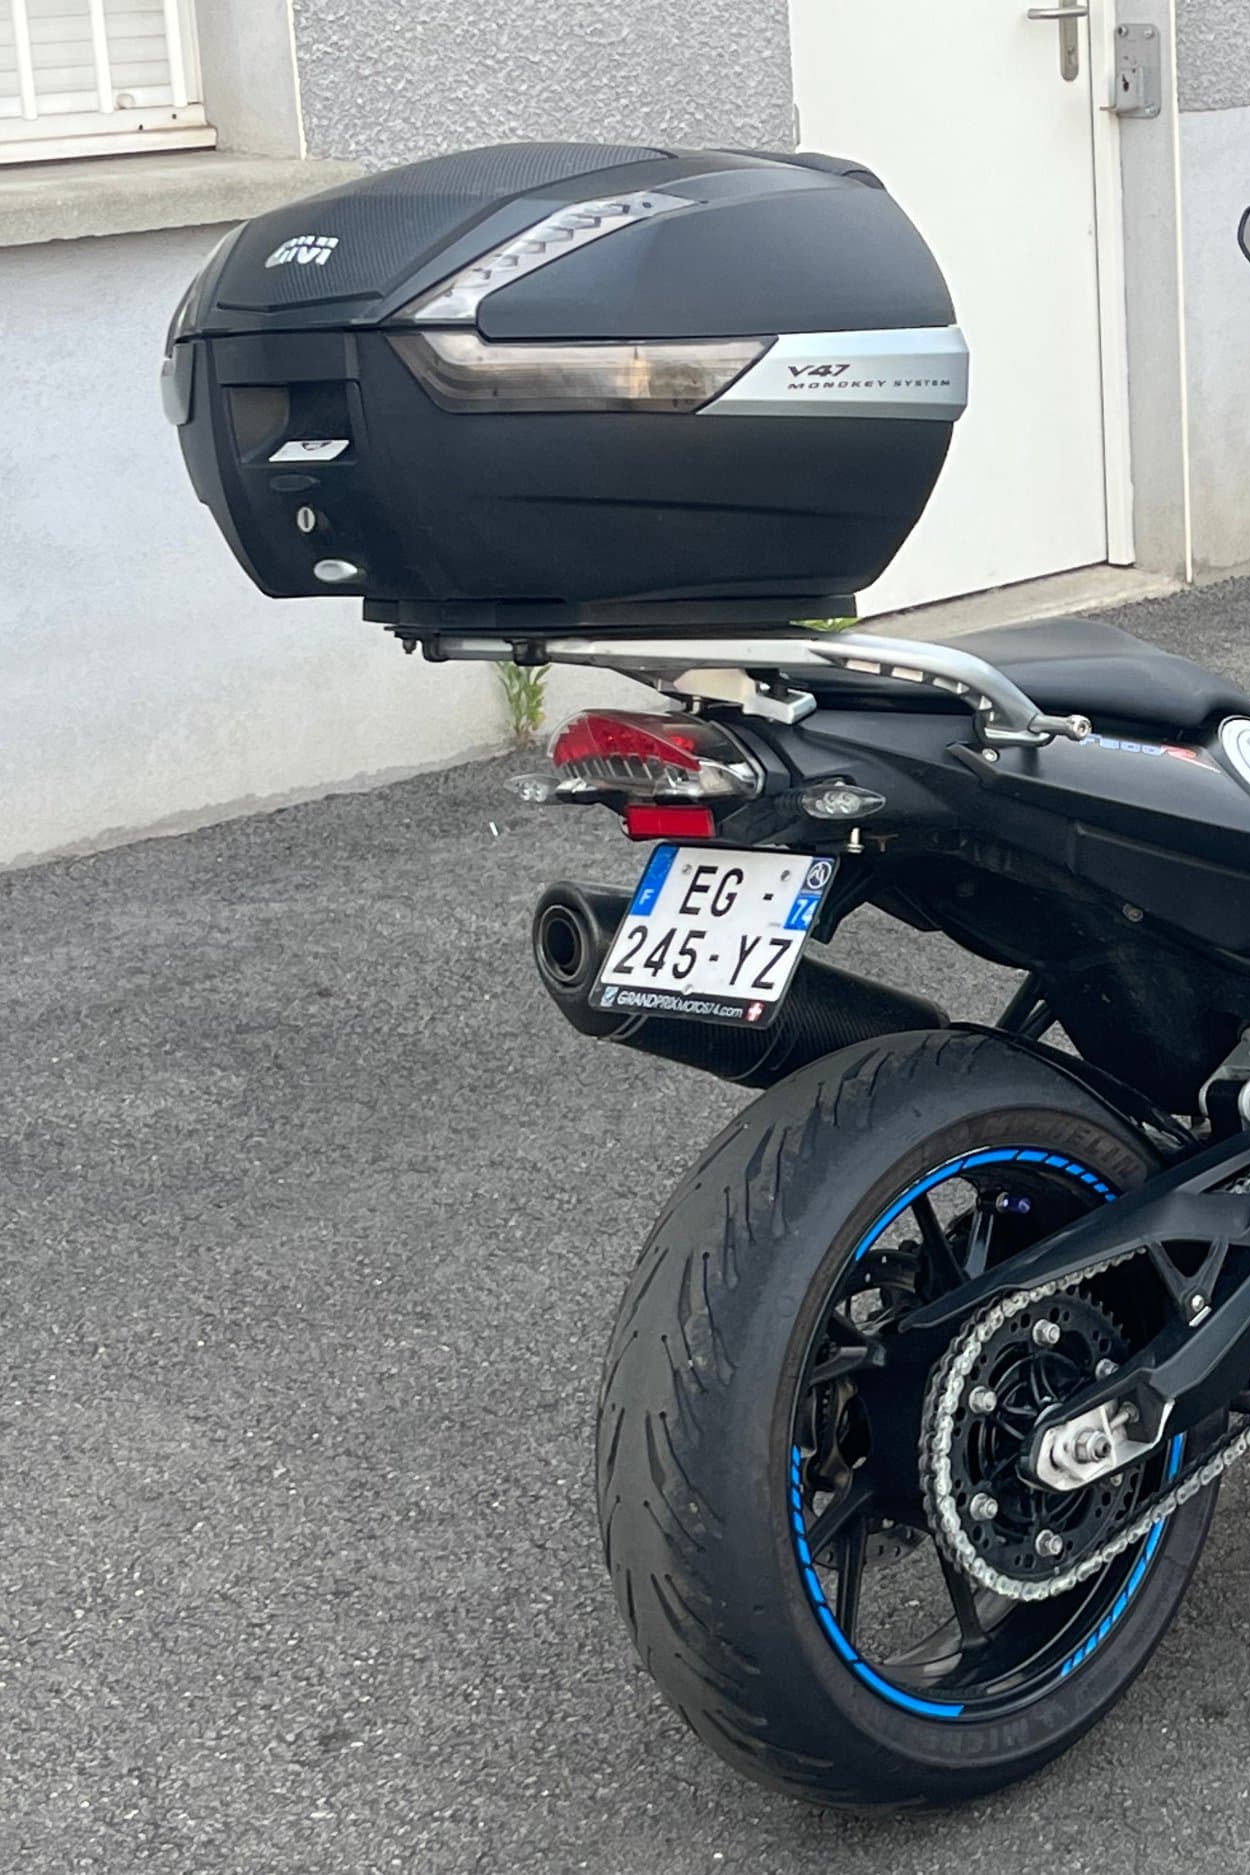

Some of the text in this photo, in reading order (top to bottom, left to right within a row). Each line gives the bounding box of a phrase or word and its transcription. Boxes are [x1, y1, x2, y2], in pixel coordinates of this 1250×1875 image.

[264, 235, 339, 268] GIVI
[788, 364, 850, 377] V47
[787, 379, 951, 389] MONOKEY SYSTEM
[639, 889, 654, 905] F
[790, 898, 819, 927] 74
